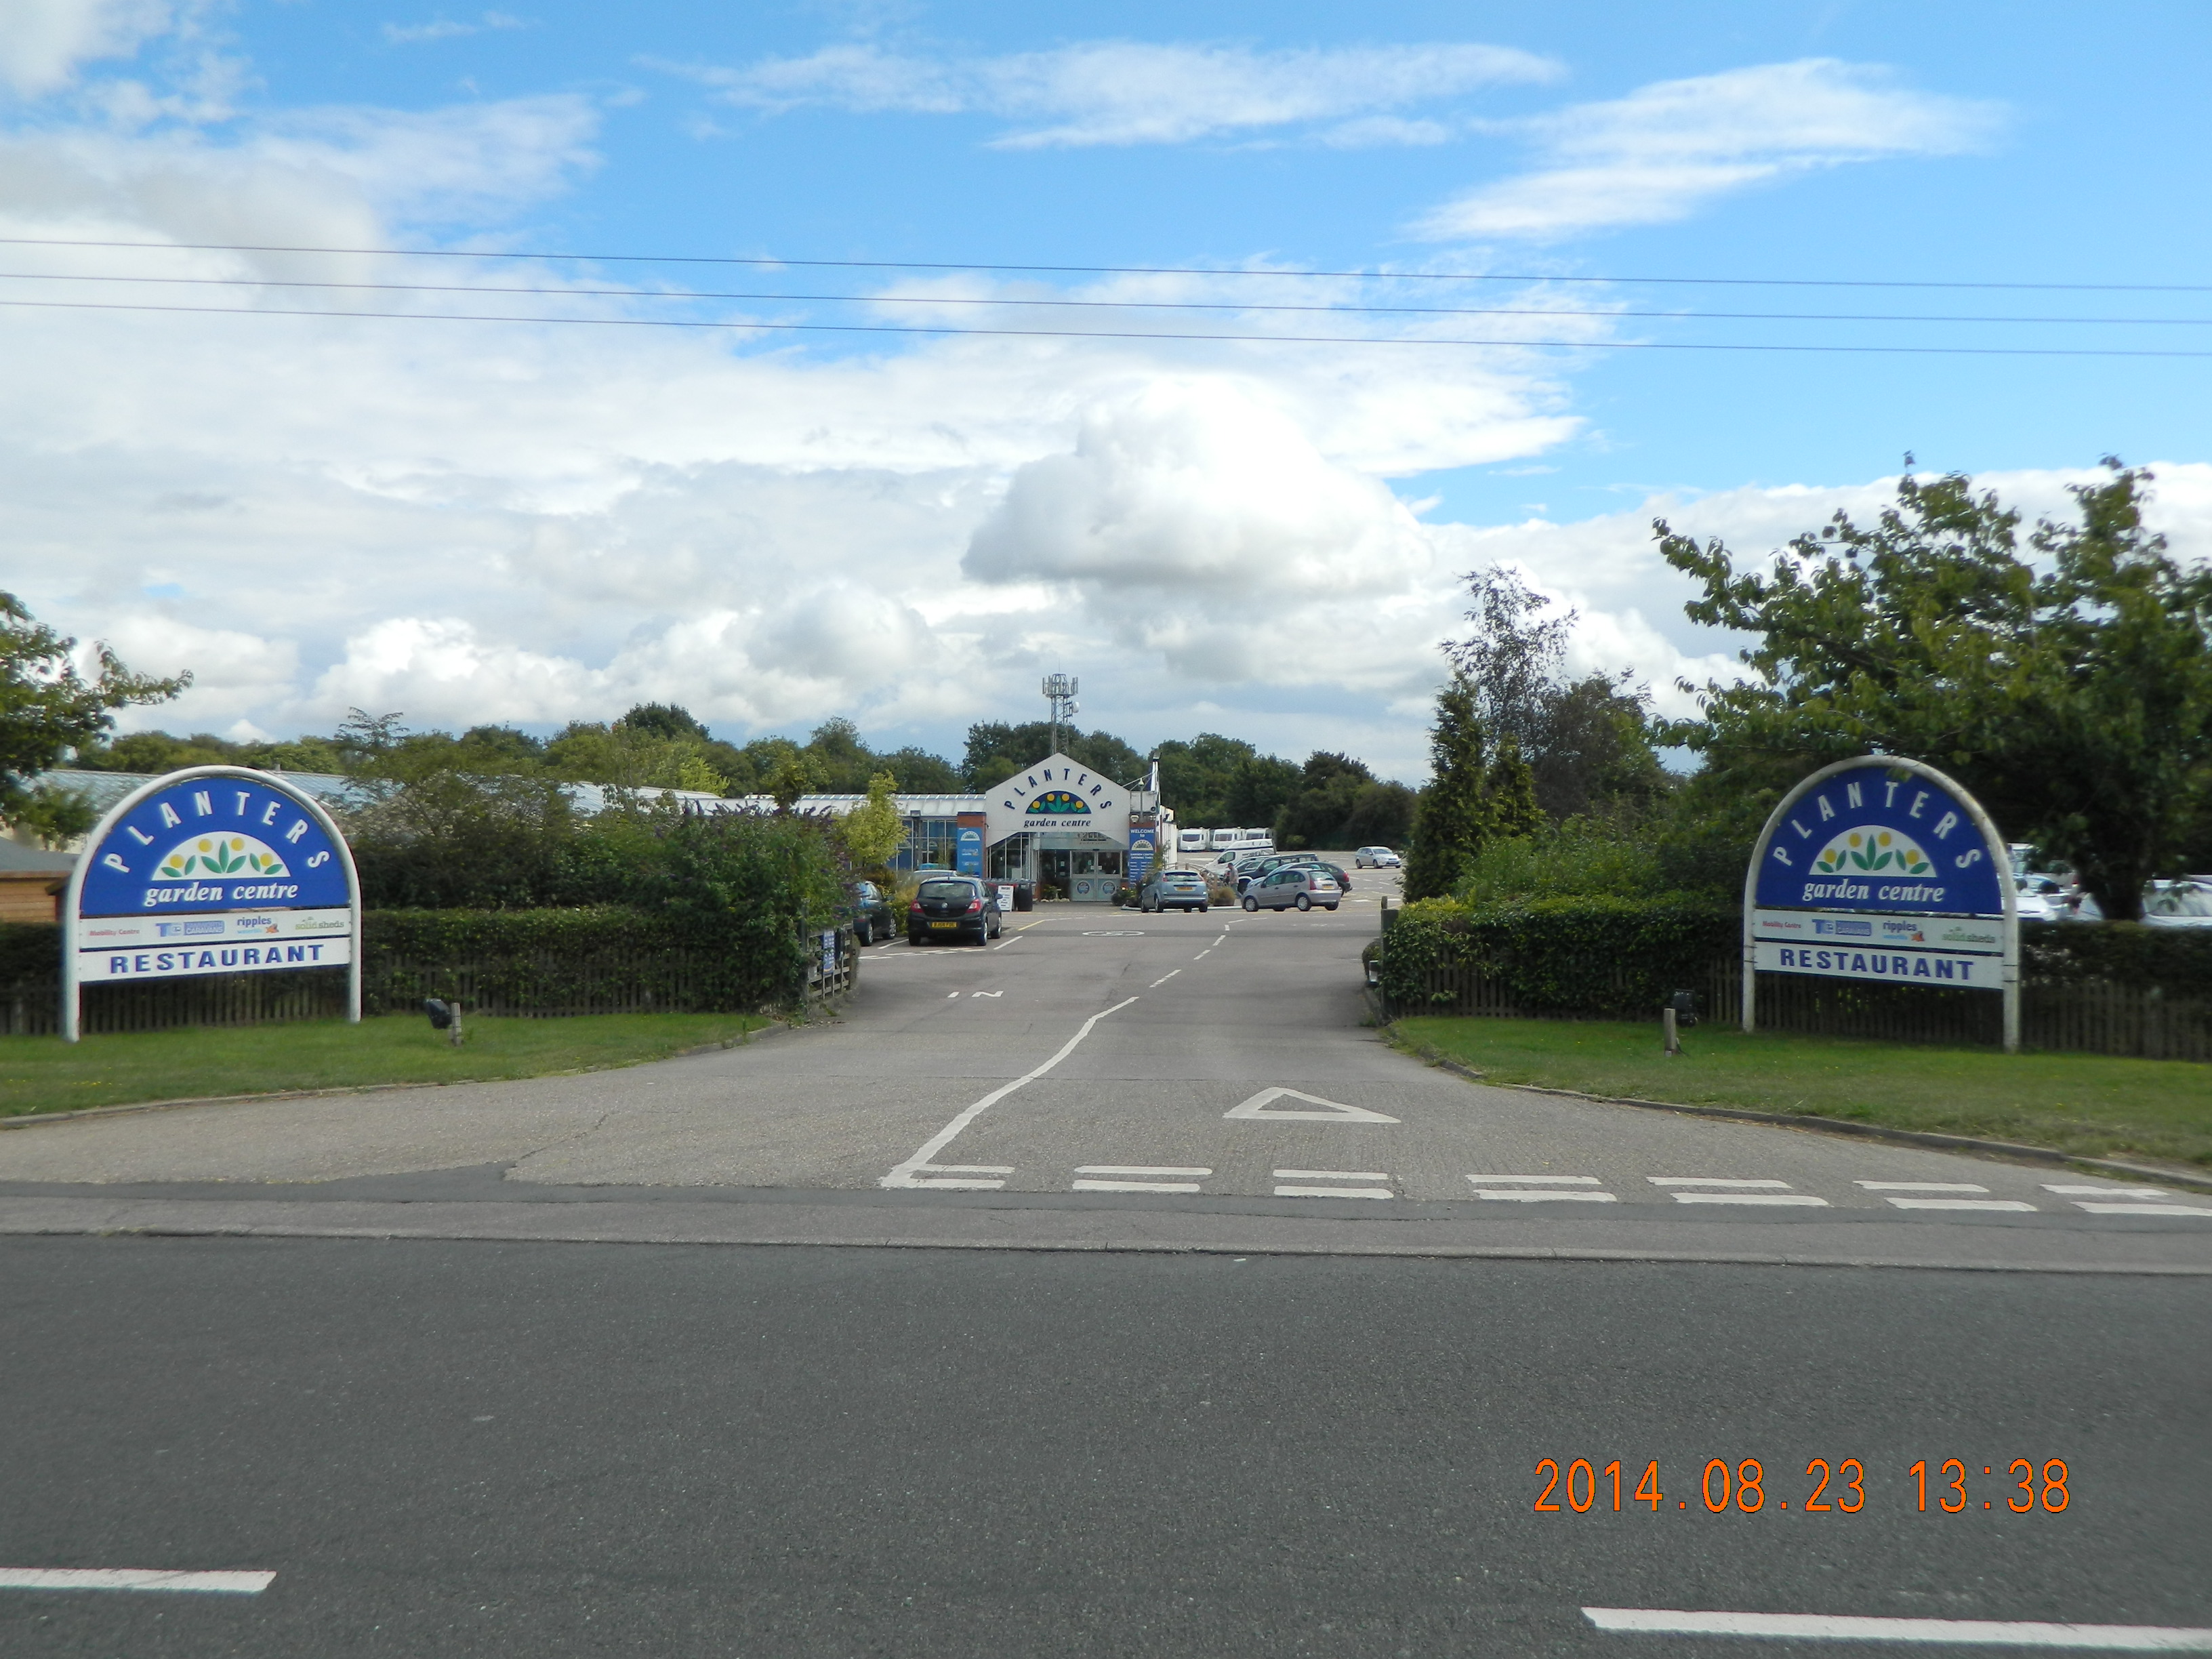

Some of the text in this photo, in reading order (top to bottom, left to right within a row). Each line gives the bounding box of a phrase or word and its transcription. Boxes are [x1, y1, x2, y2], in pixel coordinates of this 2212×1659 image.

[1004, 768, 1112, 810] PLANTERS
[104, 790, 330, 873] PLANTERS
[1023, 818, 1057, 828] garden
[1773, 781, 1982, 869] PLANTERS
[144, 882, 298, 907] garden centre
[1802, 878, 1945, 902] garden centre
[237, 916, 272, 928] ripples
[319, 920, 344, 929] sheds
[1883, 920, 1917, 933] ripples
[110, 944, 324, 974] RESTAURANT
[1780, 948, 1974, 980] RESTAURANT
[947, 990, 1004, 998] IN
